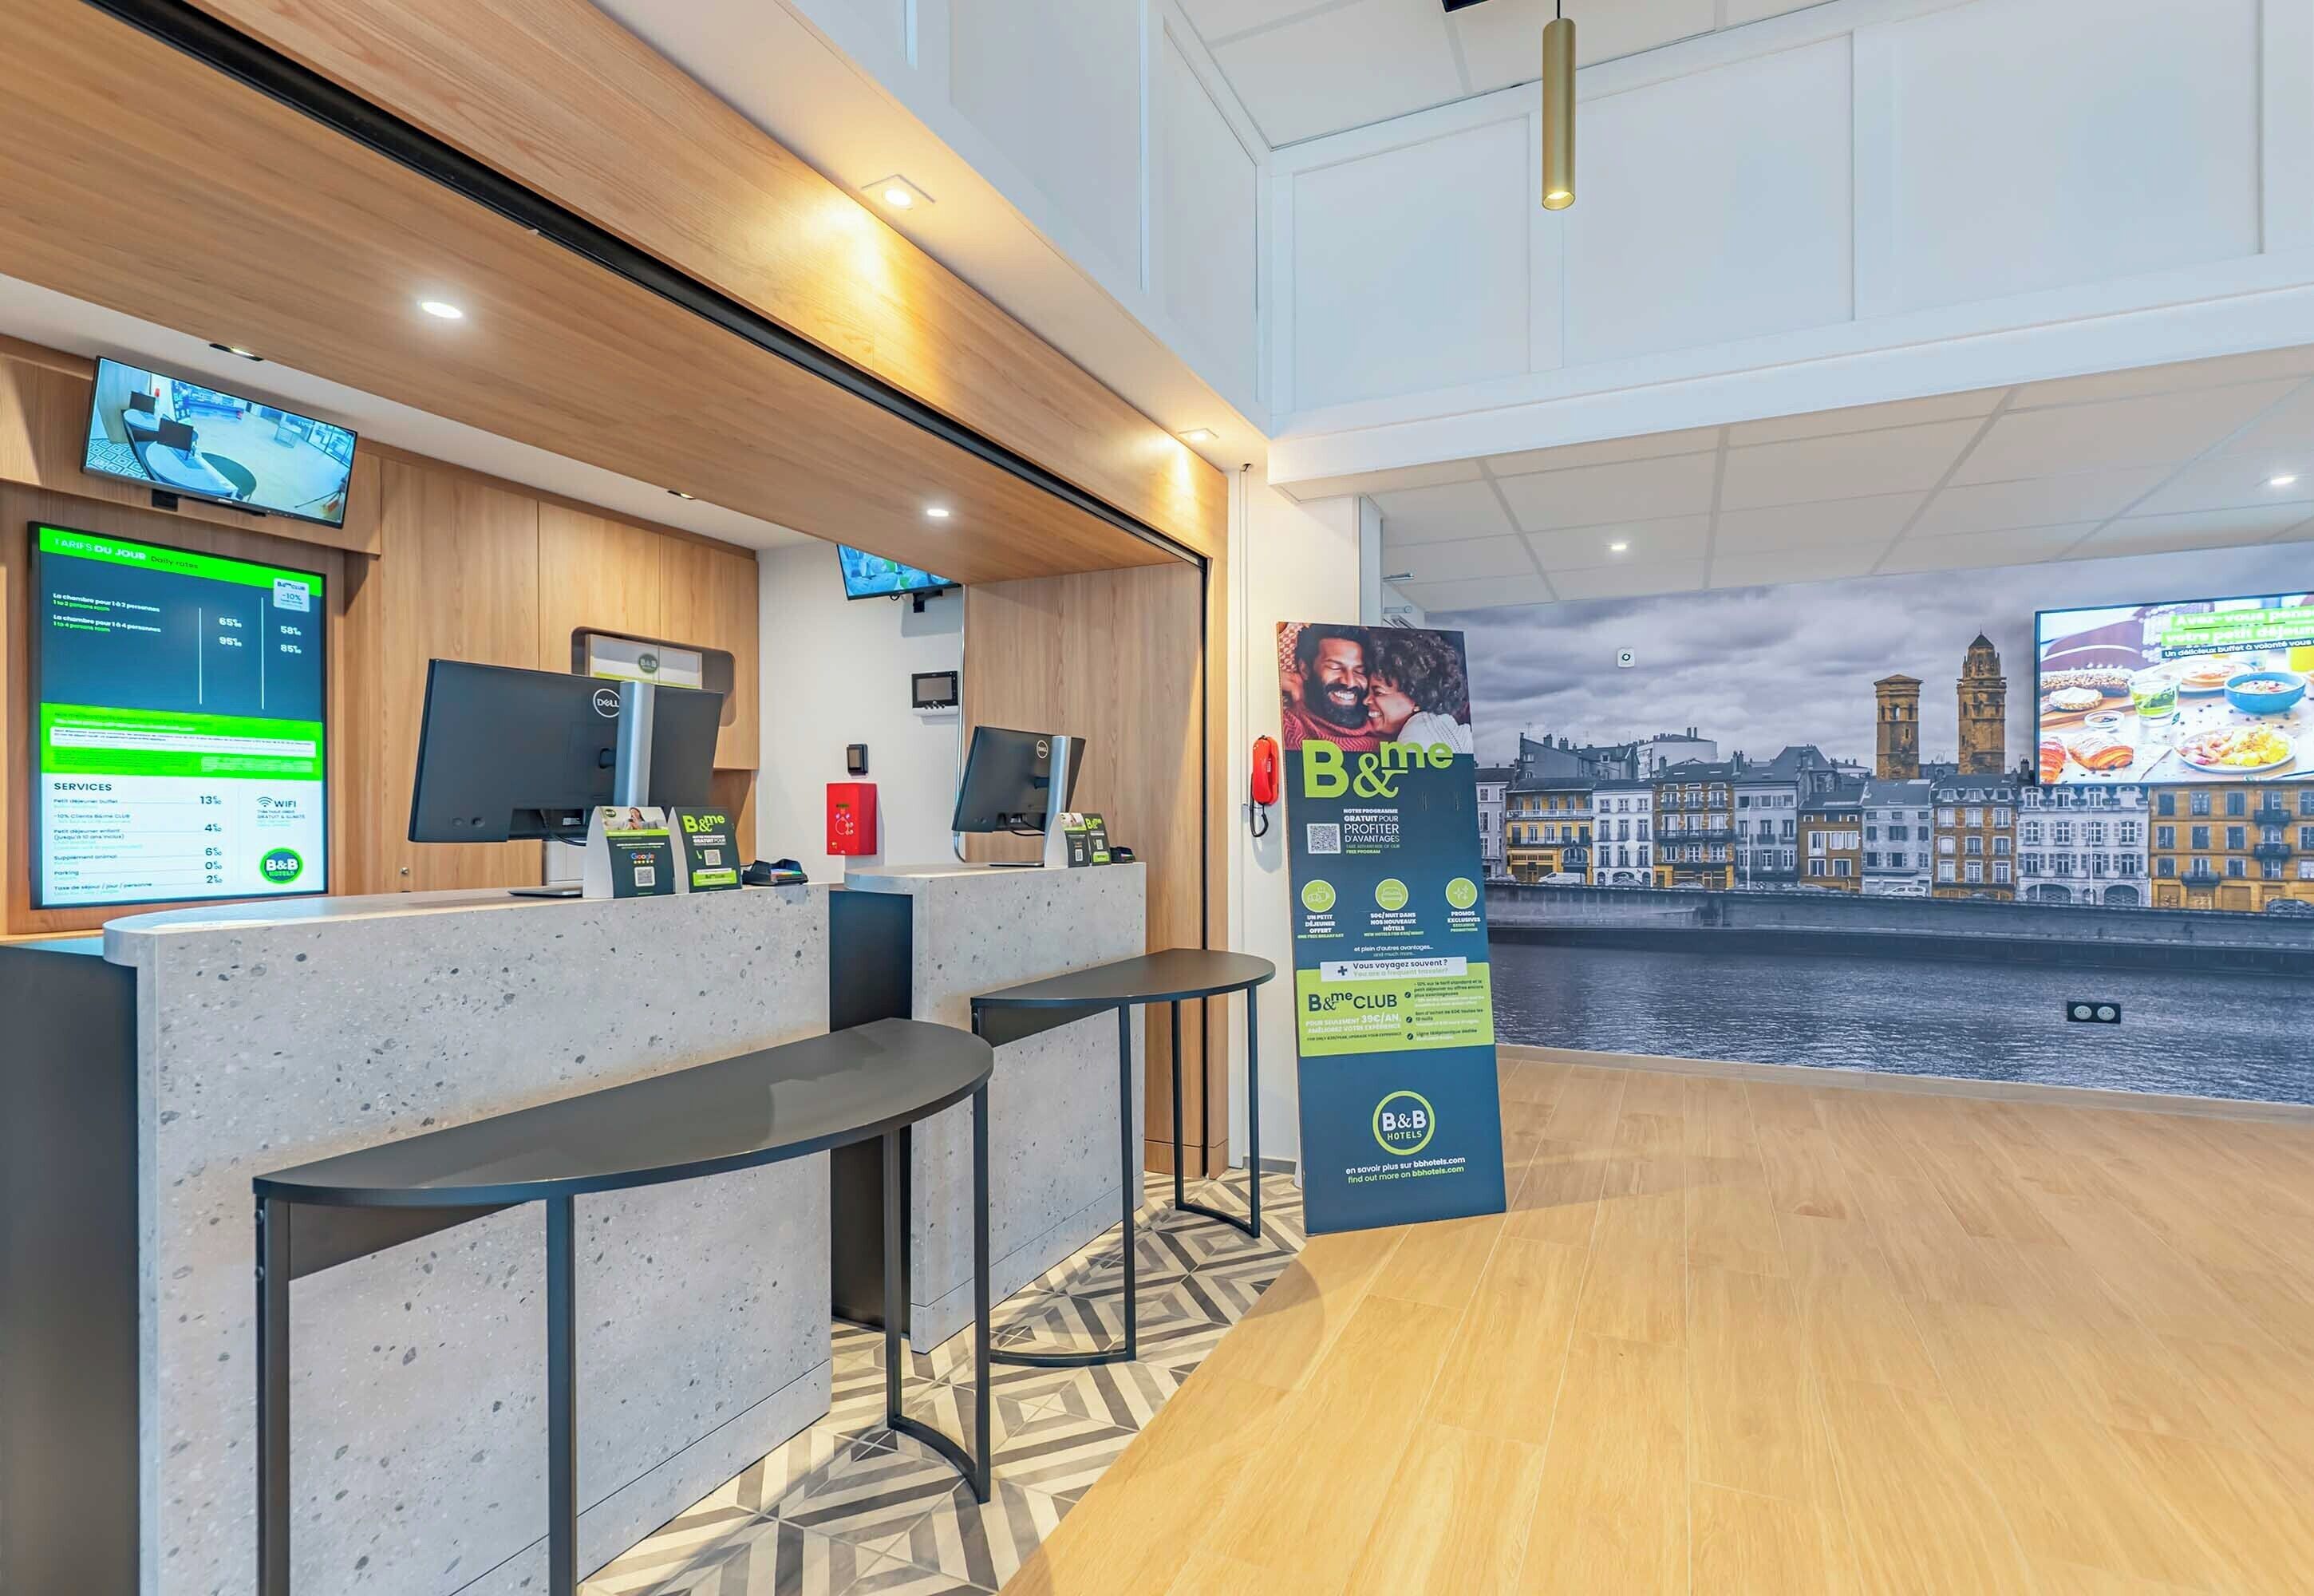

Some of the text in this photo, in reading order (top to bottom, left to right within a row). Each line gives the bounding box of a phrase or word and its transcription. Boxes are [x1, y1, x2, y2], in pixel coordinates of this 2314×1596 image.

[55, 538, 92, 551] TARIFS
[94, 545, 112, 555] DU
[115, 549, 146, 560] JOUR
[152, 555, 172, 566] Daily
[63, 595, 94, 603] chambre
[2176, 610, 2314, 626] Avez-vous pens
[2166, 632, 2209, 642] votre
[2213, 627, 2253, 644] petit
[2253, 640, 2287, 650] volonté
[1302, 739, 1453, 798] B&me
[54, 782, 112, 791] SERVICES
[682, 815, 725, 833] B&me
[1345, 824, 1399, 834] PROFITER
[267, 859, 298, 871] B&B
[1309, 992, 1352, 1012] B&me
[1353, 994, 1397, 1009] CLUB
[1382, 1110, 1427, 1131] B&B
[1388, 1131, 1422, 1140] HOTELS
[1357, 1164, 1381, 1173] savoir
[1383, 1163, 1398, 1172] plus
[1414, 1157, 1466, 1168] bbhotels.com
[1348, 1175, 1363, 1184] find
[1412, 1167, 1464, 1177] bbhotels.com
